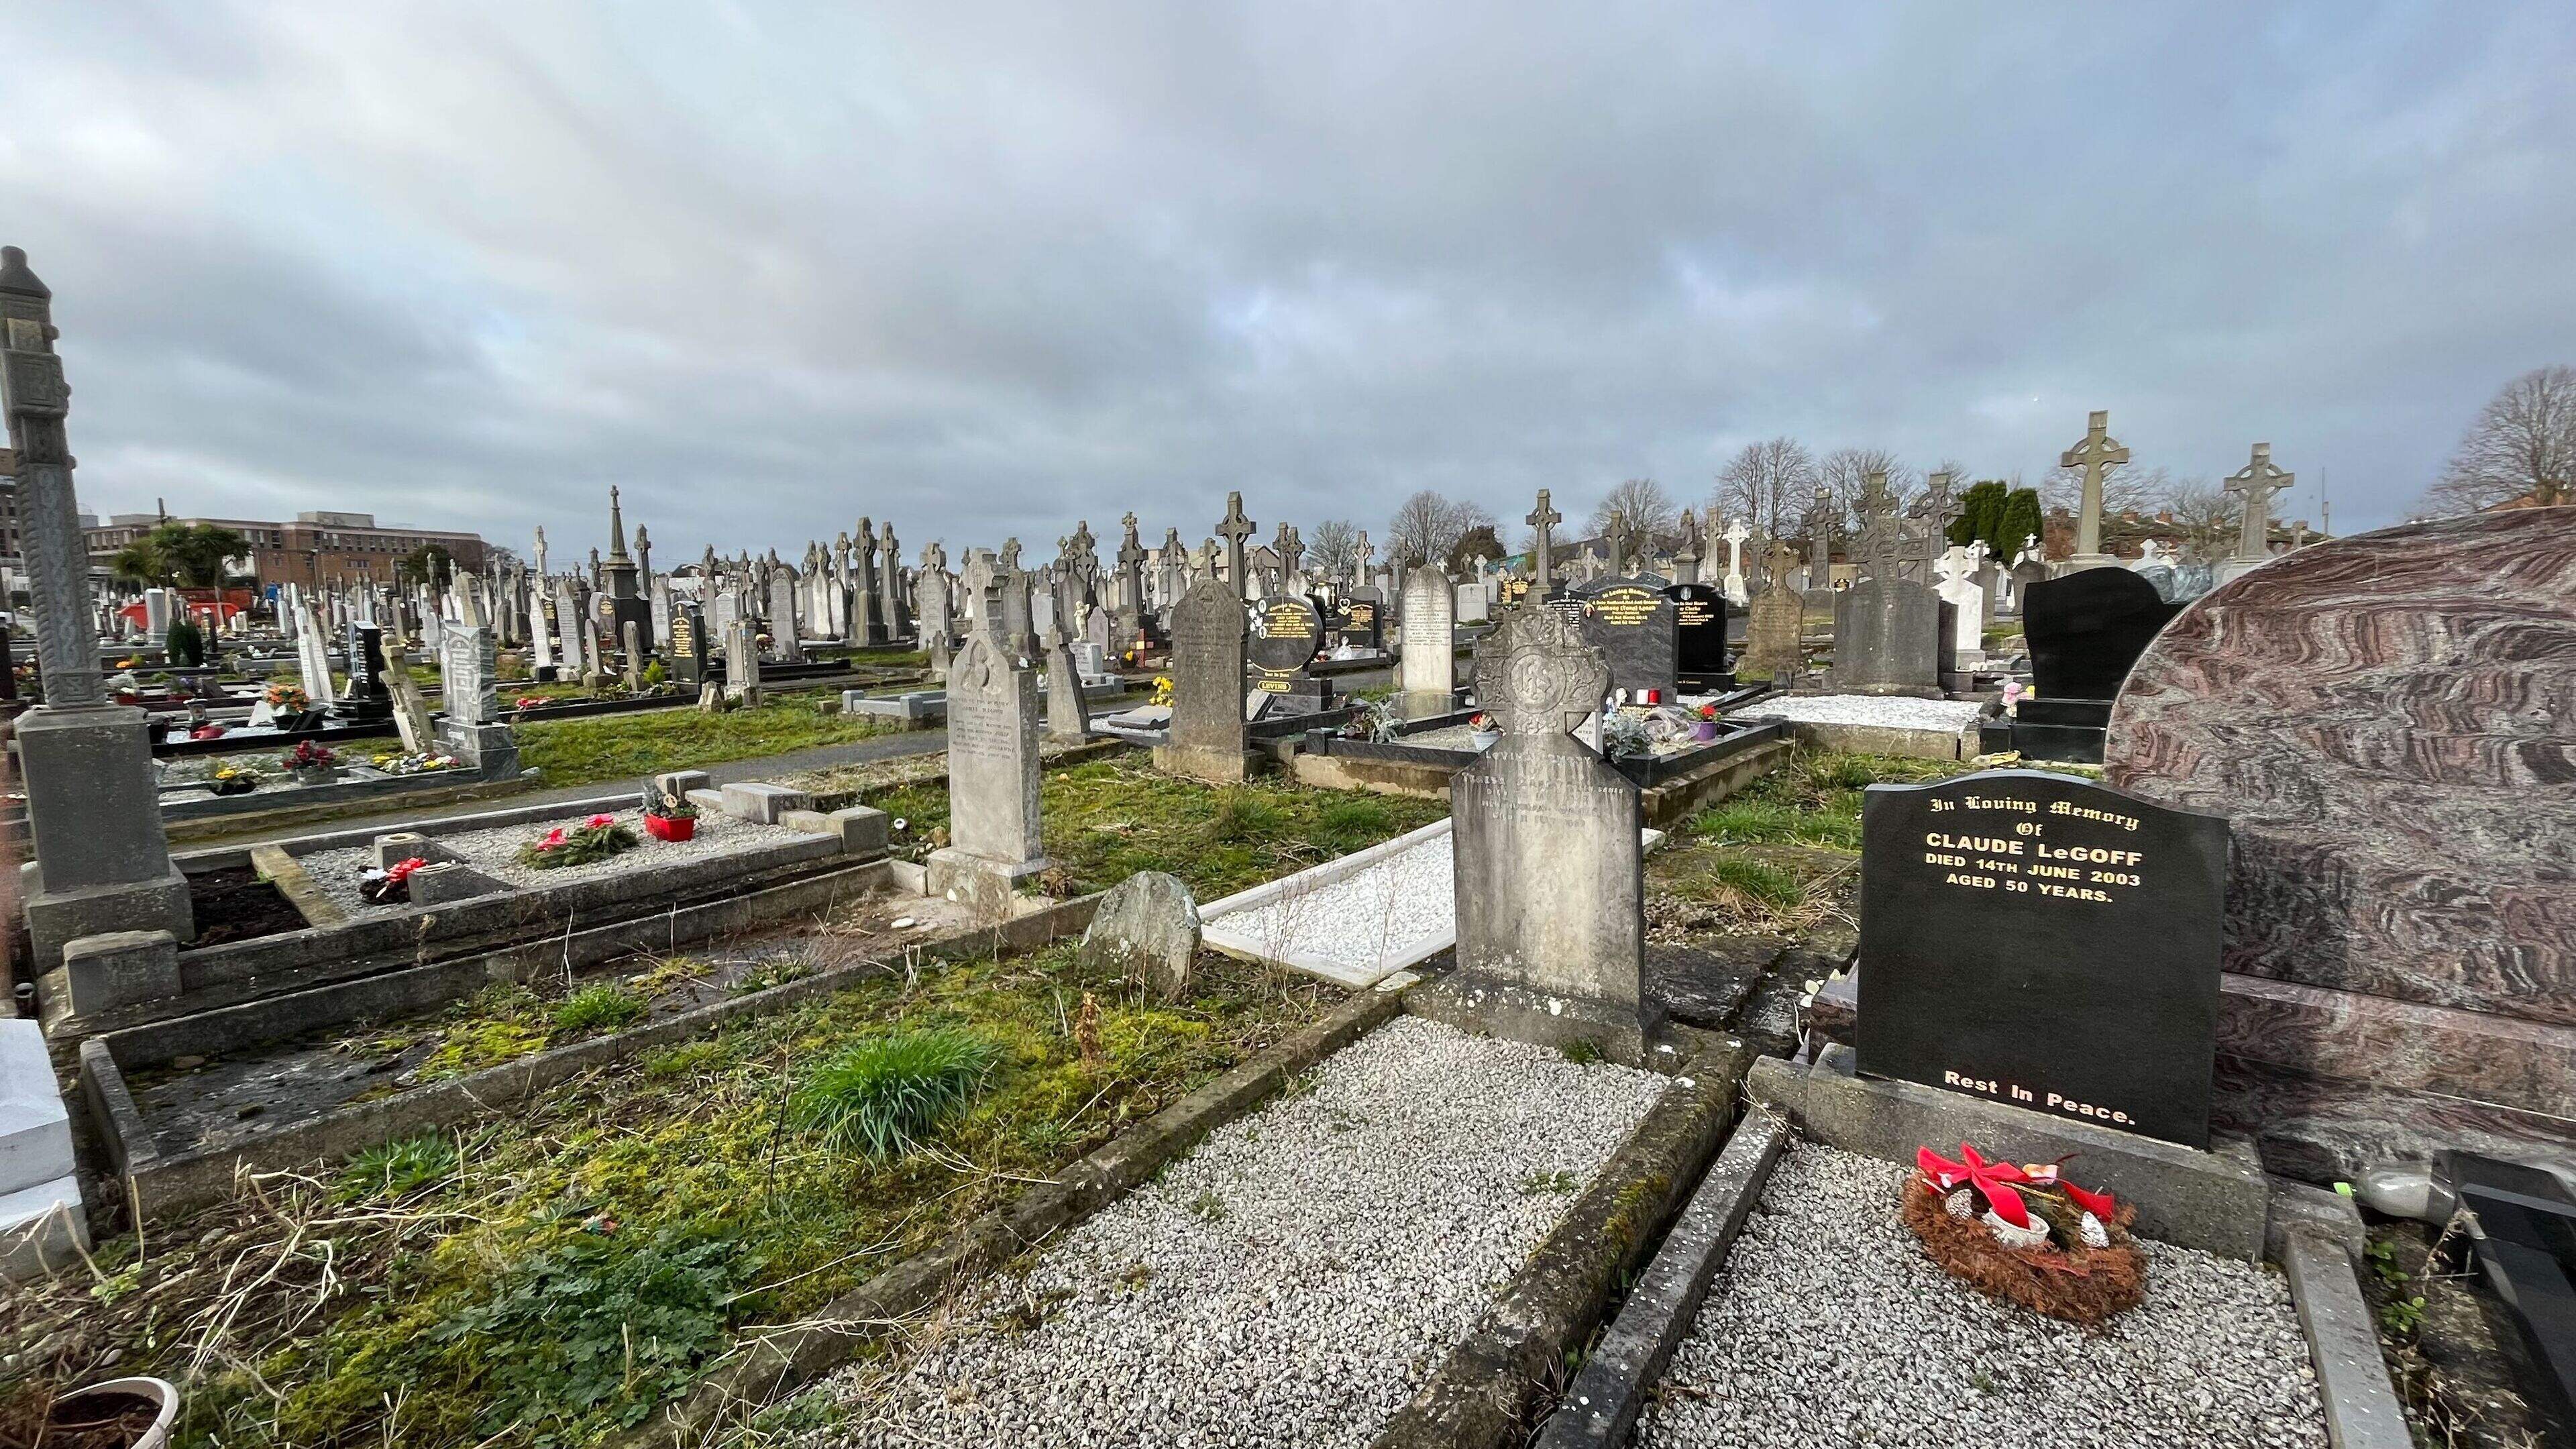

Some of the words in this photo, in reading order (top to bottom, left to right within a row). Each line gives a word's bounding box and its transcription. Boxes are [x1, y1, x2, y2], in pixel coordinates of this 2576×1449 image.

[1930, 798, 1955, 812] In
[1965, 796, 2037, 814] Loving
[2049, 800, 2140, 831] Memory
[2016, 822, 2043, 837] Of
[1926, 832, 2025, 855] CLAUDE
[2038, 843, 2143, 867] LeGOFF
[1925, 853, 1966, 867] DIED
[1976, 859, 2018, 873] 14TH
[2027, 864, 2080, 880] JUNE
[2090, 871, 2141, 887] 2003
[1945, 873, 1996, 889] AGED
[2005, 879, 2029, 893] 50
[2037, 882, 2114, 903] YEARS.
[1945, 1070, 1998, 1094] Rest
[2011, 1084, 2033, 1102] In
[2047, 1092, 2136, 1126] Peace.
